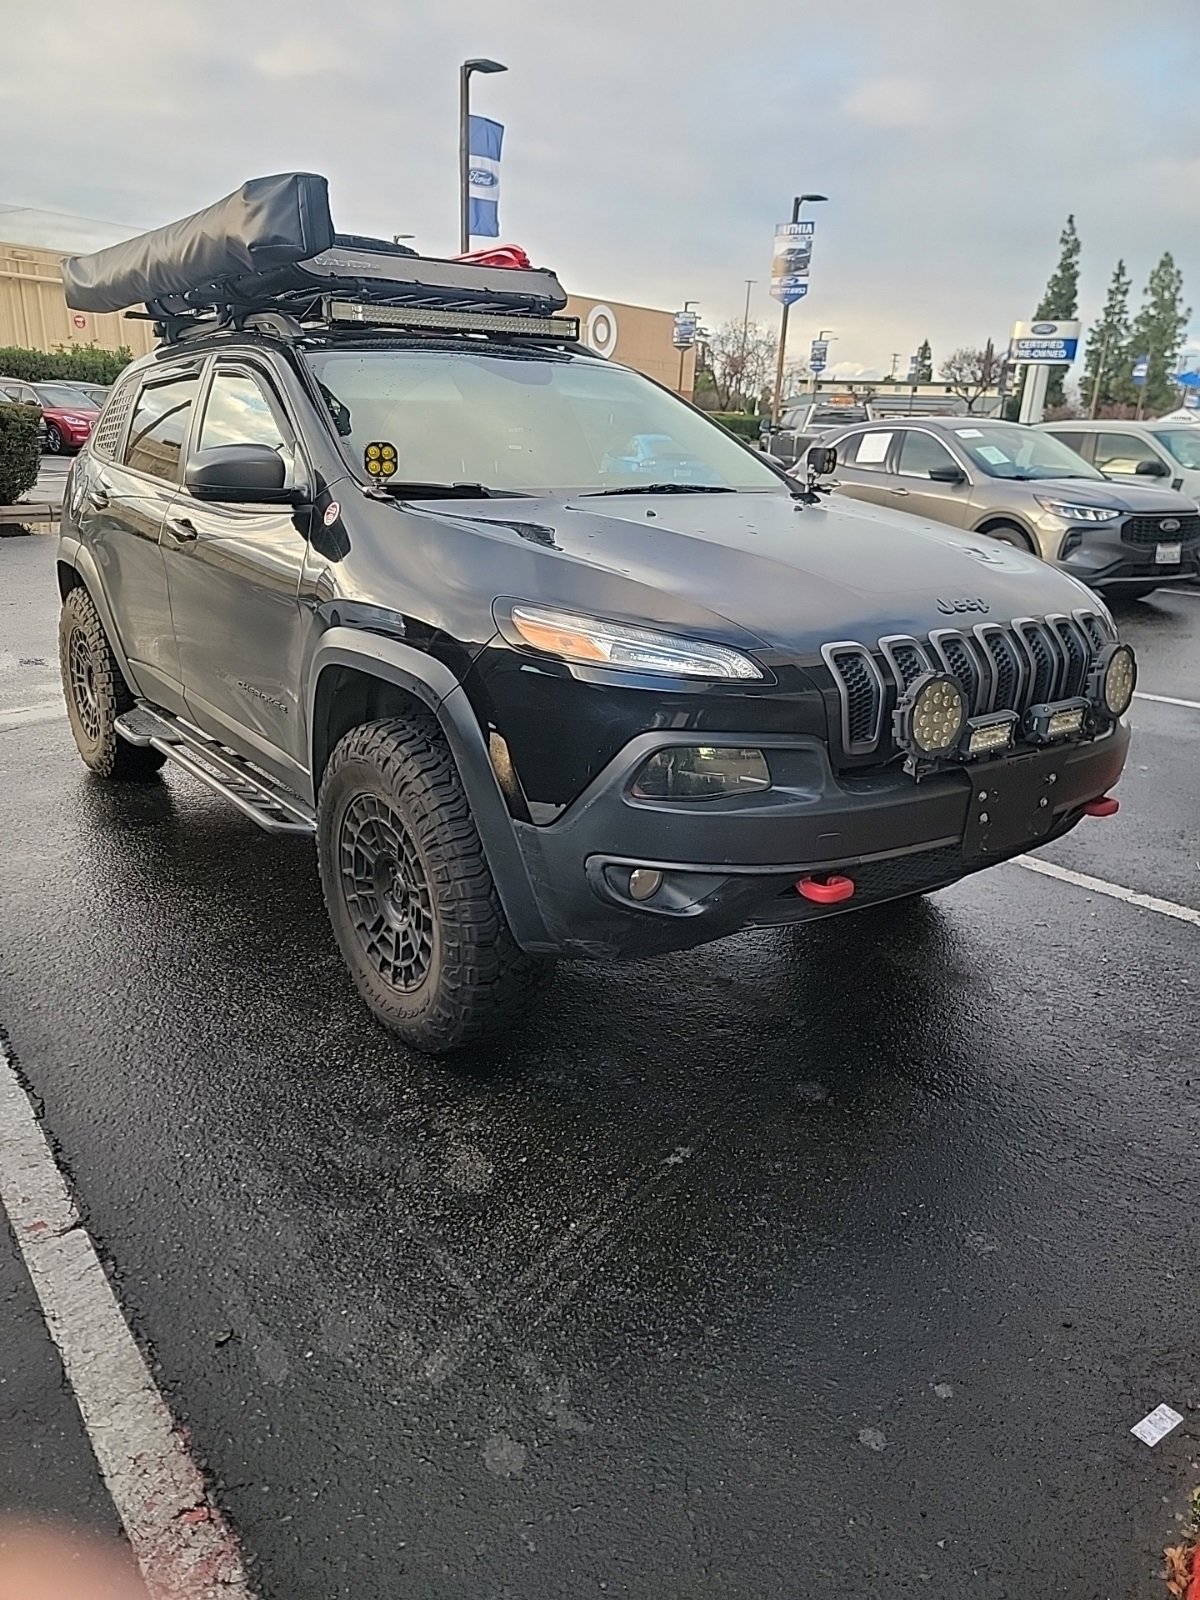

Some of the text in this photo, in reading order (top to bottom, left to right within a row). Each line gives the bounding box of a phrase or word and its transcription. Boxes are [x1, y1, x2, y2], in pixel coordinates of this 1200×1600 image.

[469, 169, 493, 186] Ford
[1018, 340, 1065, 349] CERTIFIED
[1014, 350, 1067, 358] PRE-OWNED
[936, 598, 990, 615] Jeep
